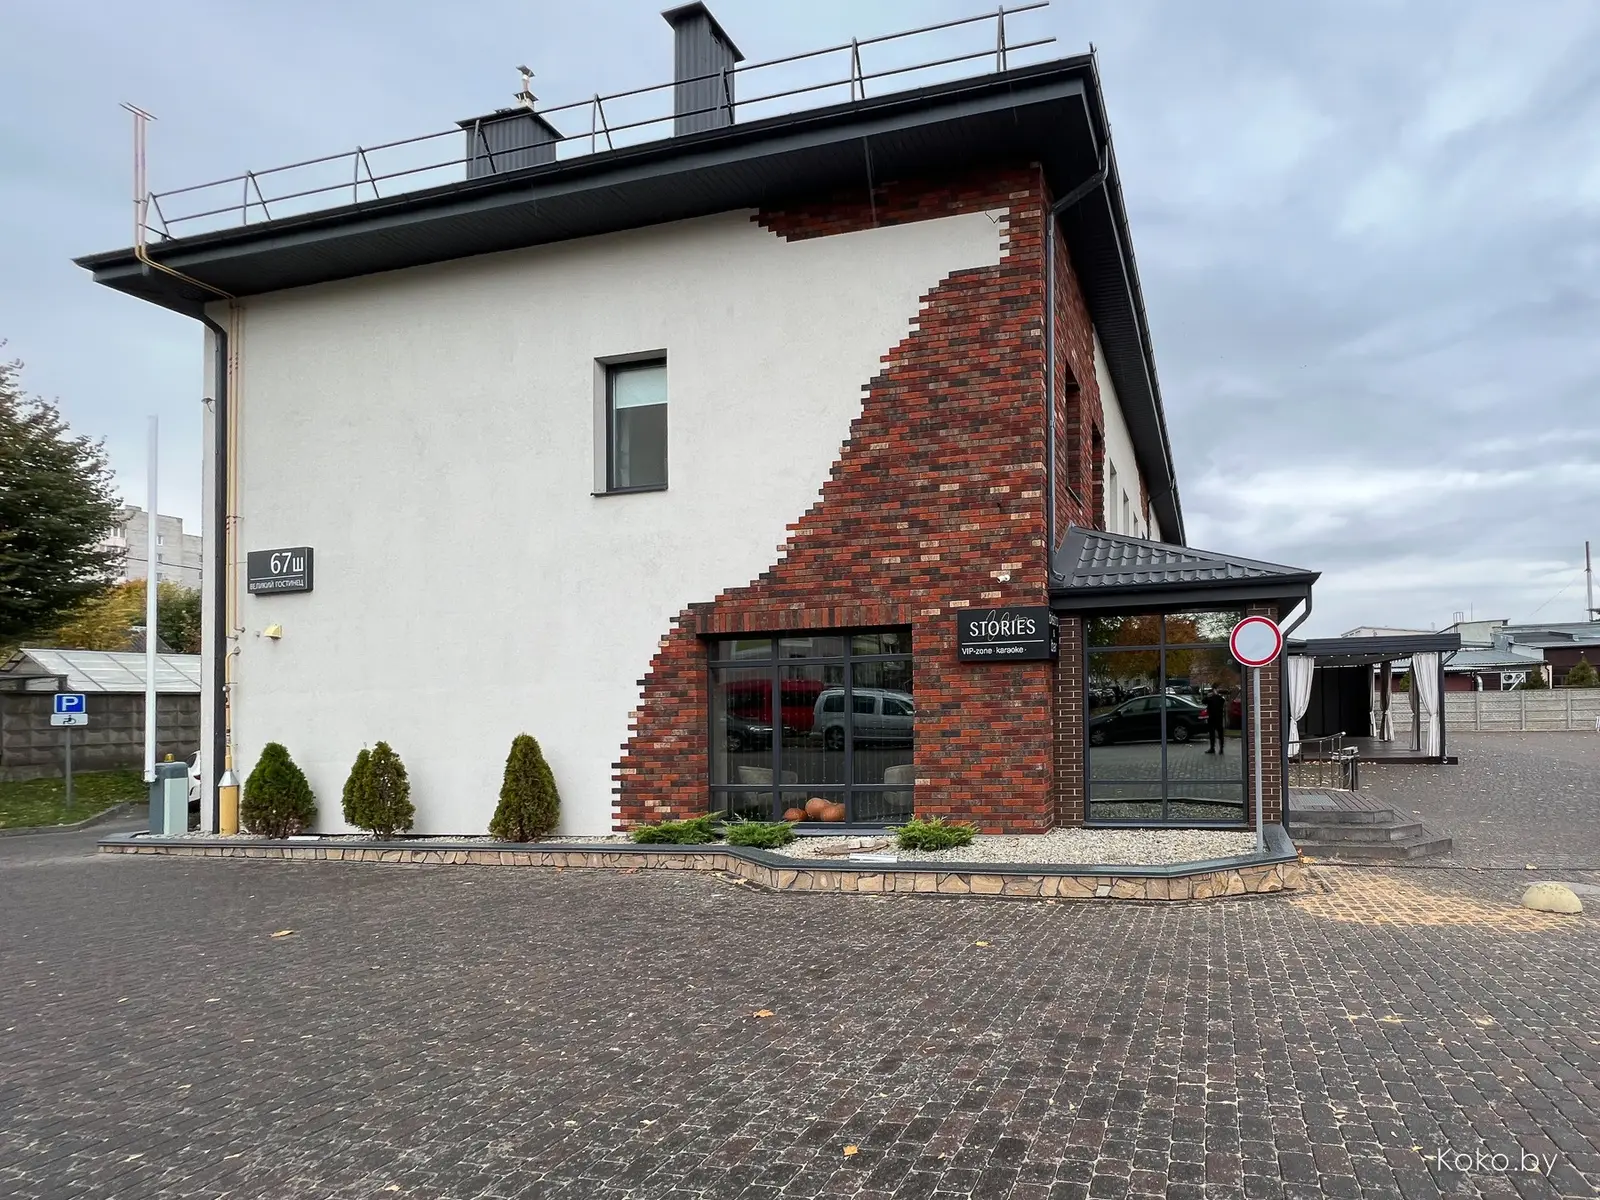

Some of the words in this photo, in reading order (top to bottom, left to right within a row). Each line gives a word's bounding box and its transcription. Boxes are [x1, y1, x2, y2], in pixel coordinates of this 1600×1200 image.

[275, 579, 304, 588] ГОСТИНЕЦ
[969, 619, 1036, 637] STORIES
[961, 647, 992, 655] VIP-zone
[995, 646, 1024, 655] karaoke
[62, 696, 79, 711] P
